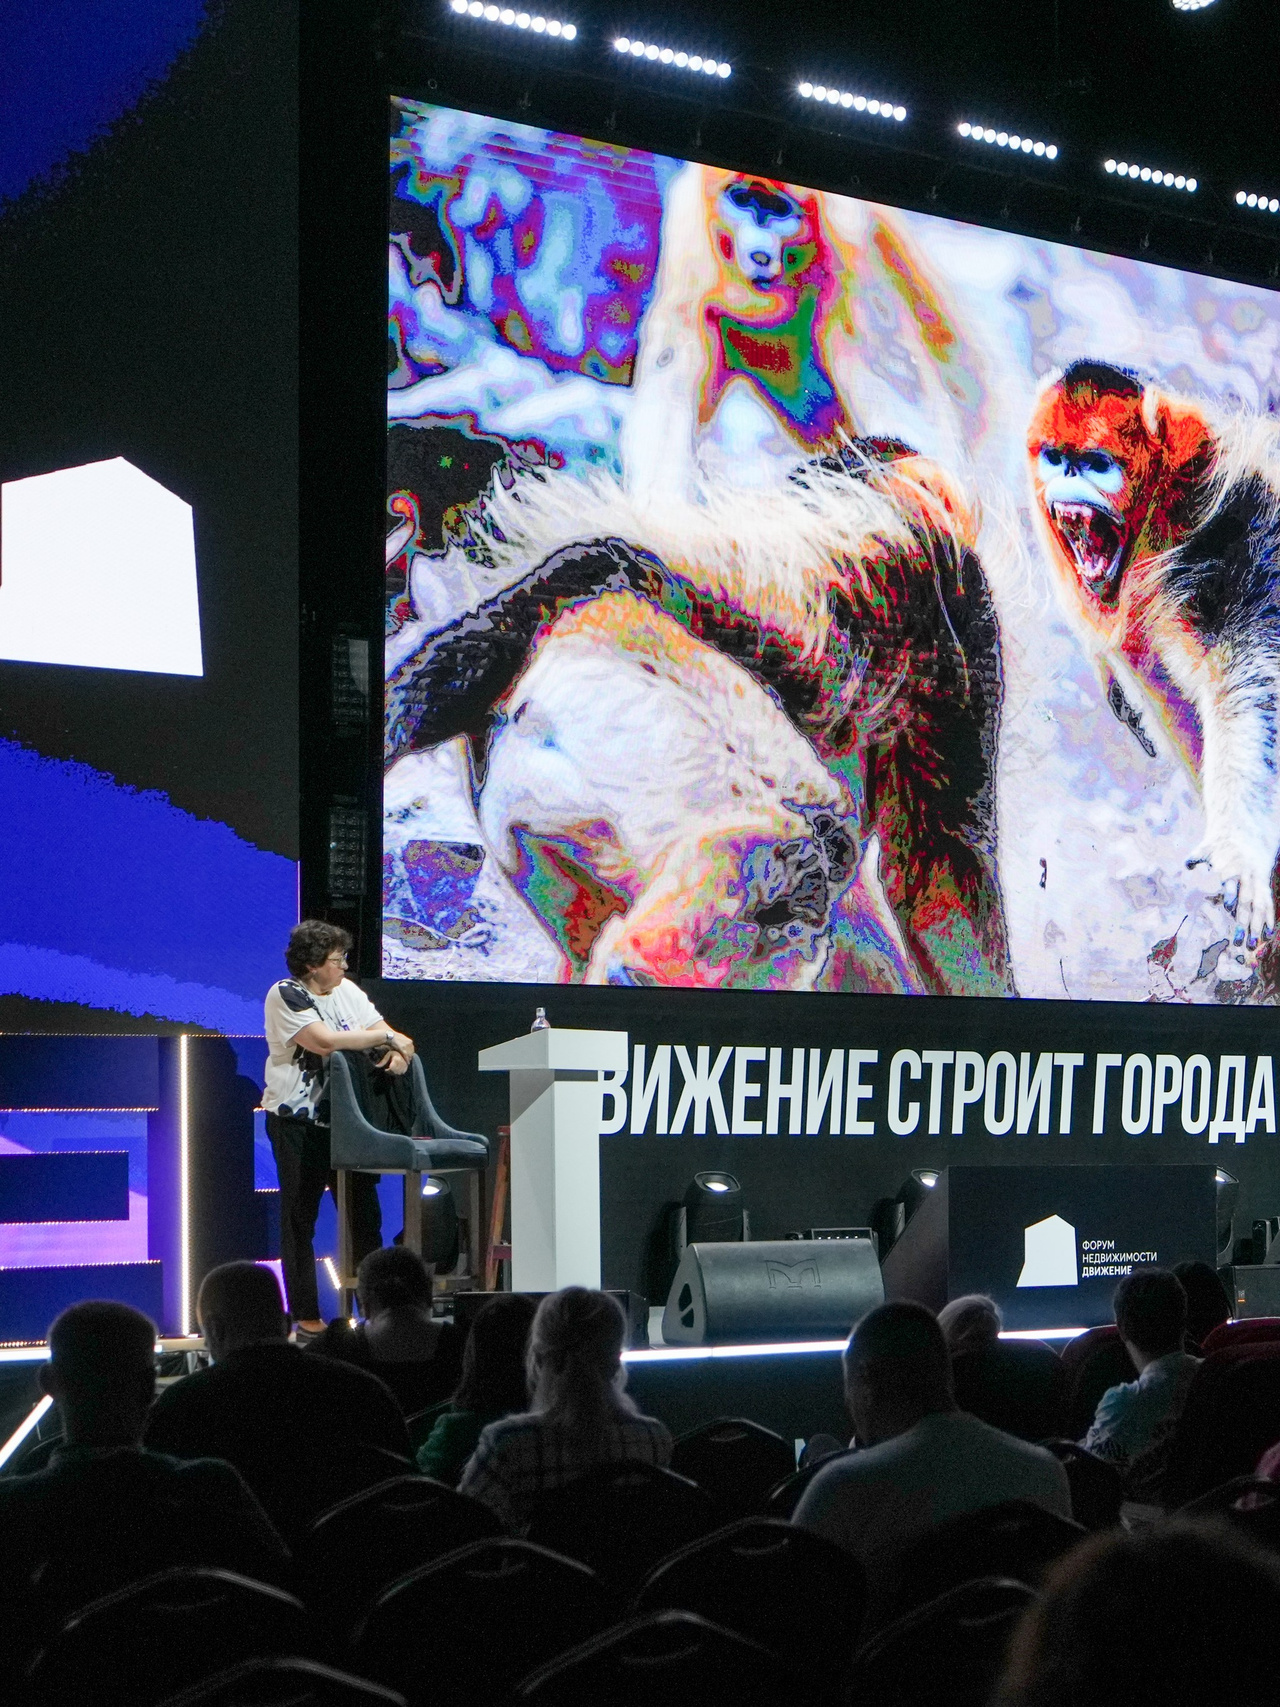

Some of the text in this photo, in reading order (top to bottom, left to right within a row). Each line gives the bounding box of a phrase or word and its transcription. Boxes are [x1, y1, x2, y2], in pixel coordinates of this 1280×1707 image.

[887, 1048, 1084, 1136] СТРОИТ
[1092, 1053, 1276, 1143] ГОРОДА
[1082, 1240, 1115, 1250] ФОРУМ
[1082, 1252, 1158, 1264] НЕДВИЖИМОСТИ
[1082, 1265, 1132, 1278] ДВИЖЕНИЕ
